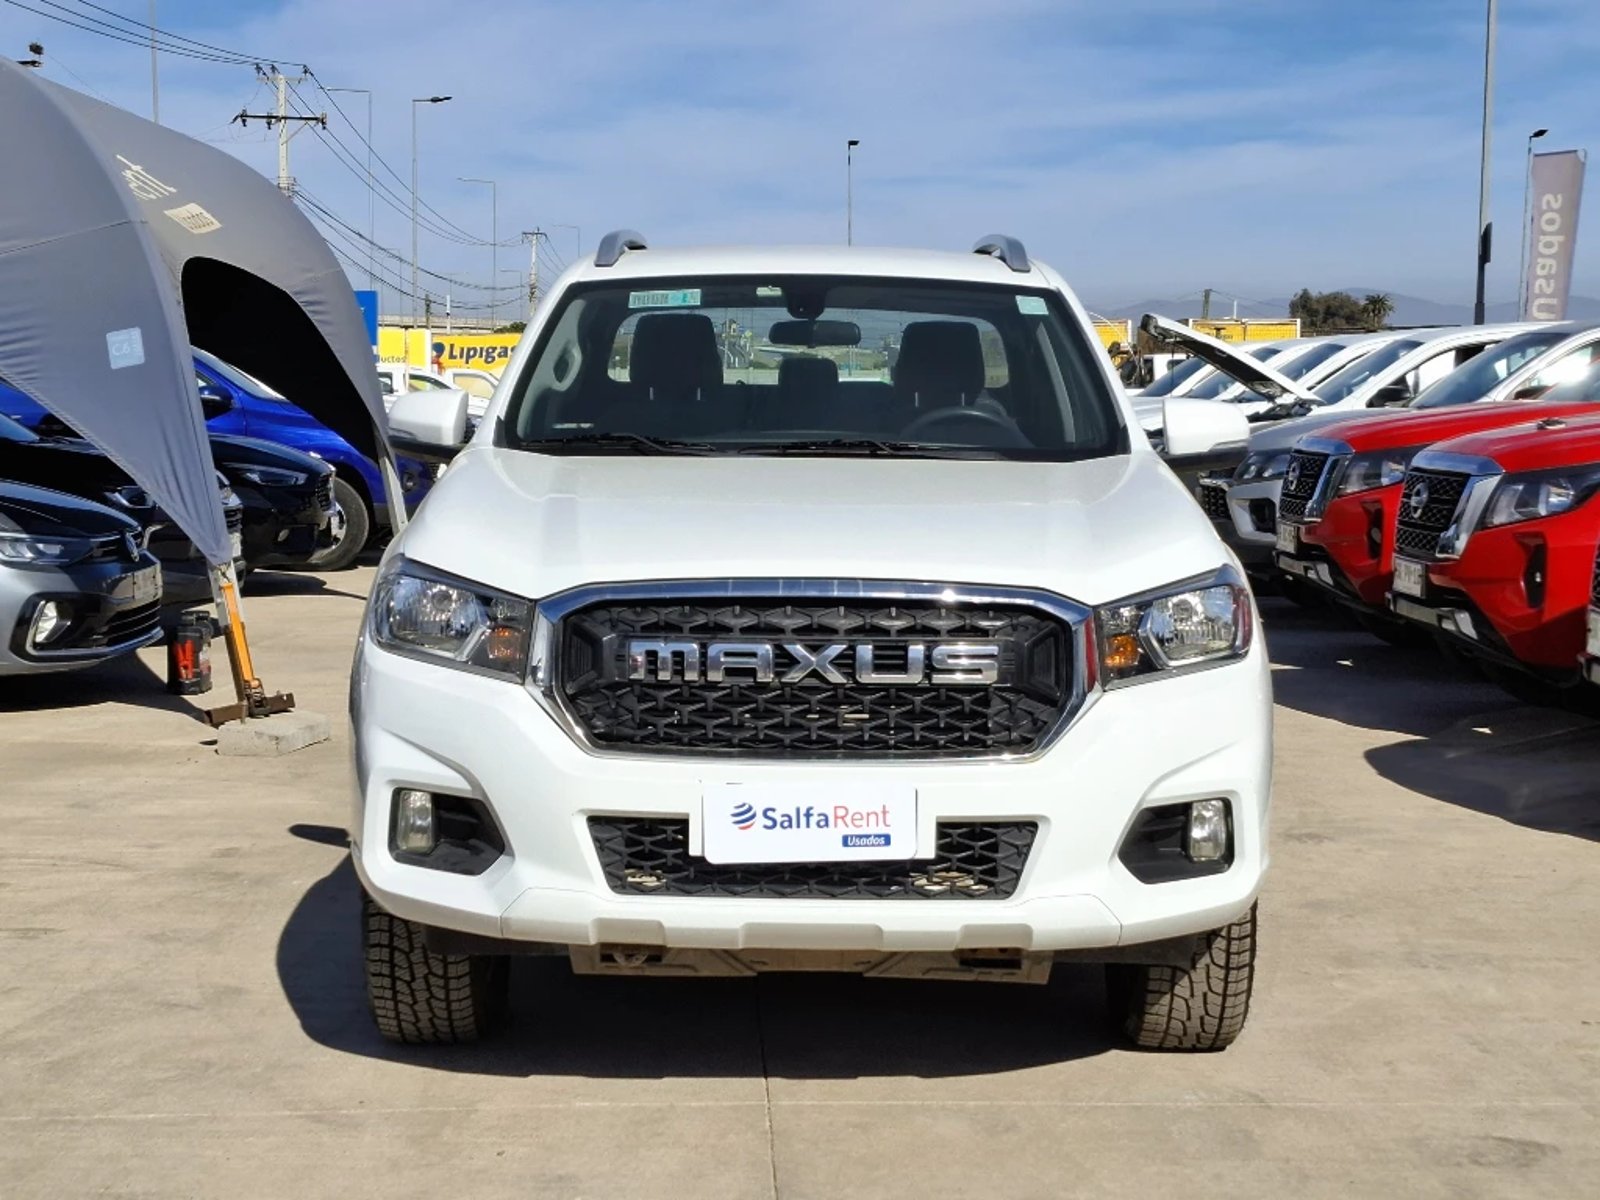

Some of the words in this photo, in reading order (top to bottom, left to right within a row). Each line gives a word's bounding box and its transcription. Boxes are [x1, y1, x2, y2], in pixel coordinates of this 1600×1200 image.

[378, 355, 406, 363] uctos
[448, 343, 516, 365] Lipiga
[628, 640, 1000, 685] MAXUS
[761, 803, 892, 830] SalfaRent
[847, 835, 886, 846] Usados
